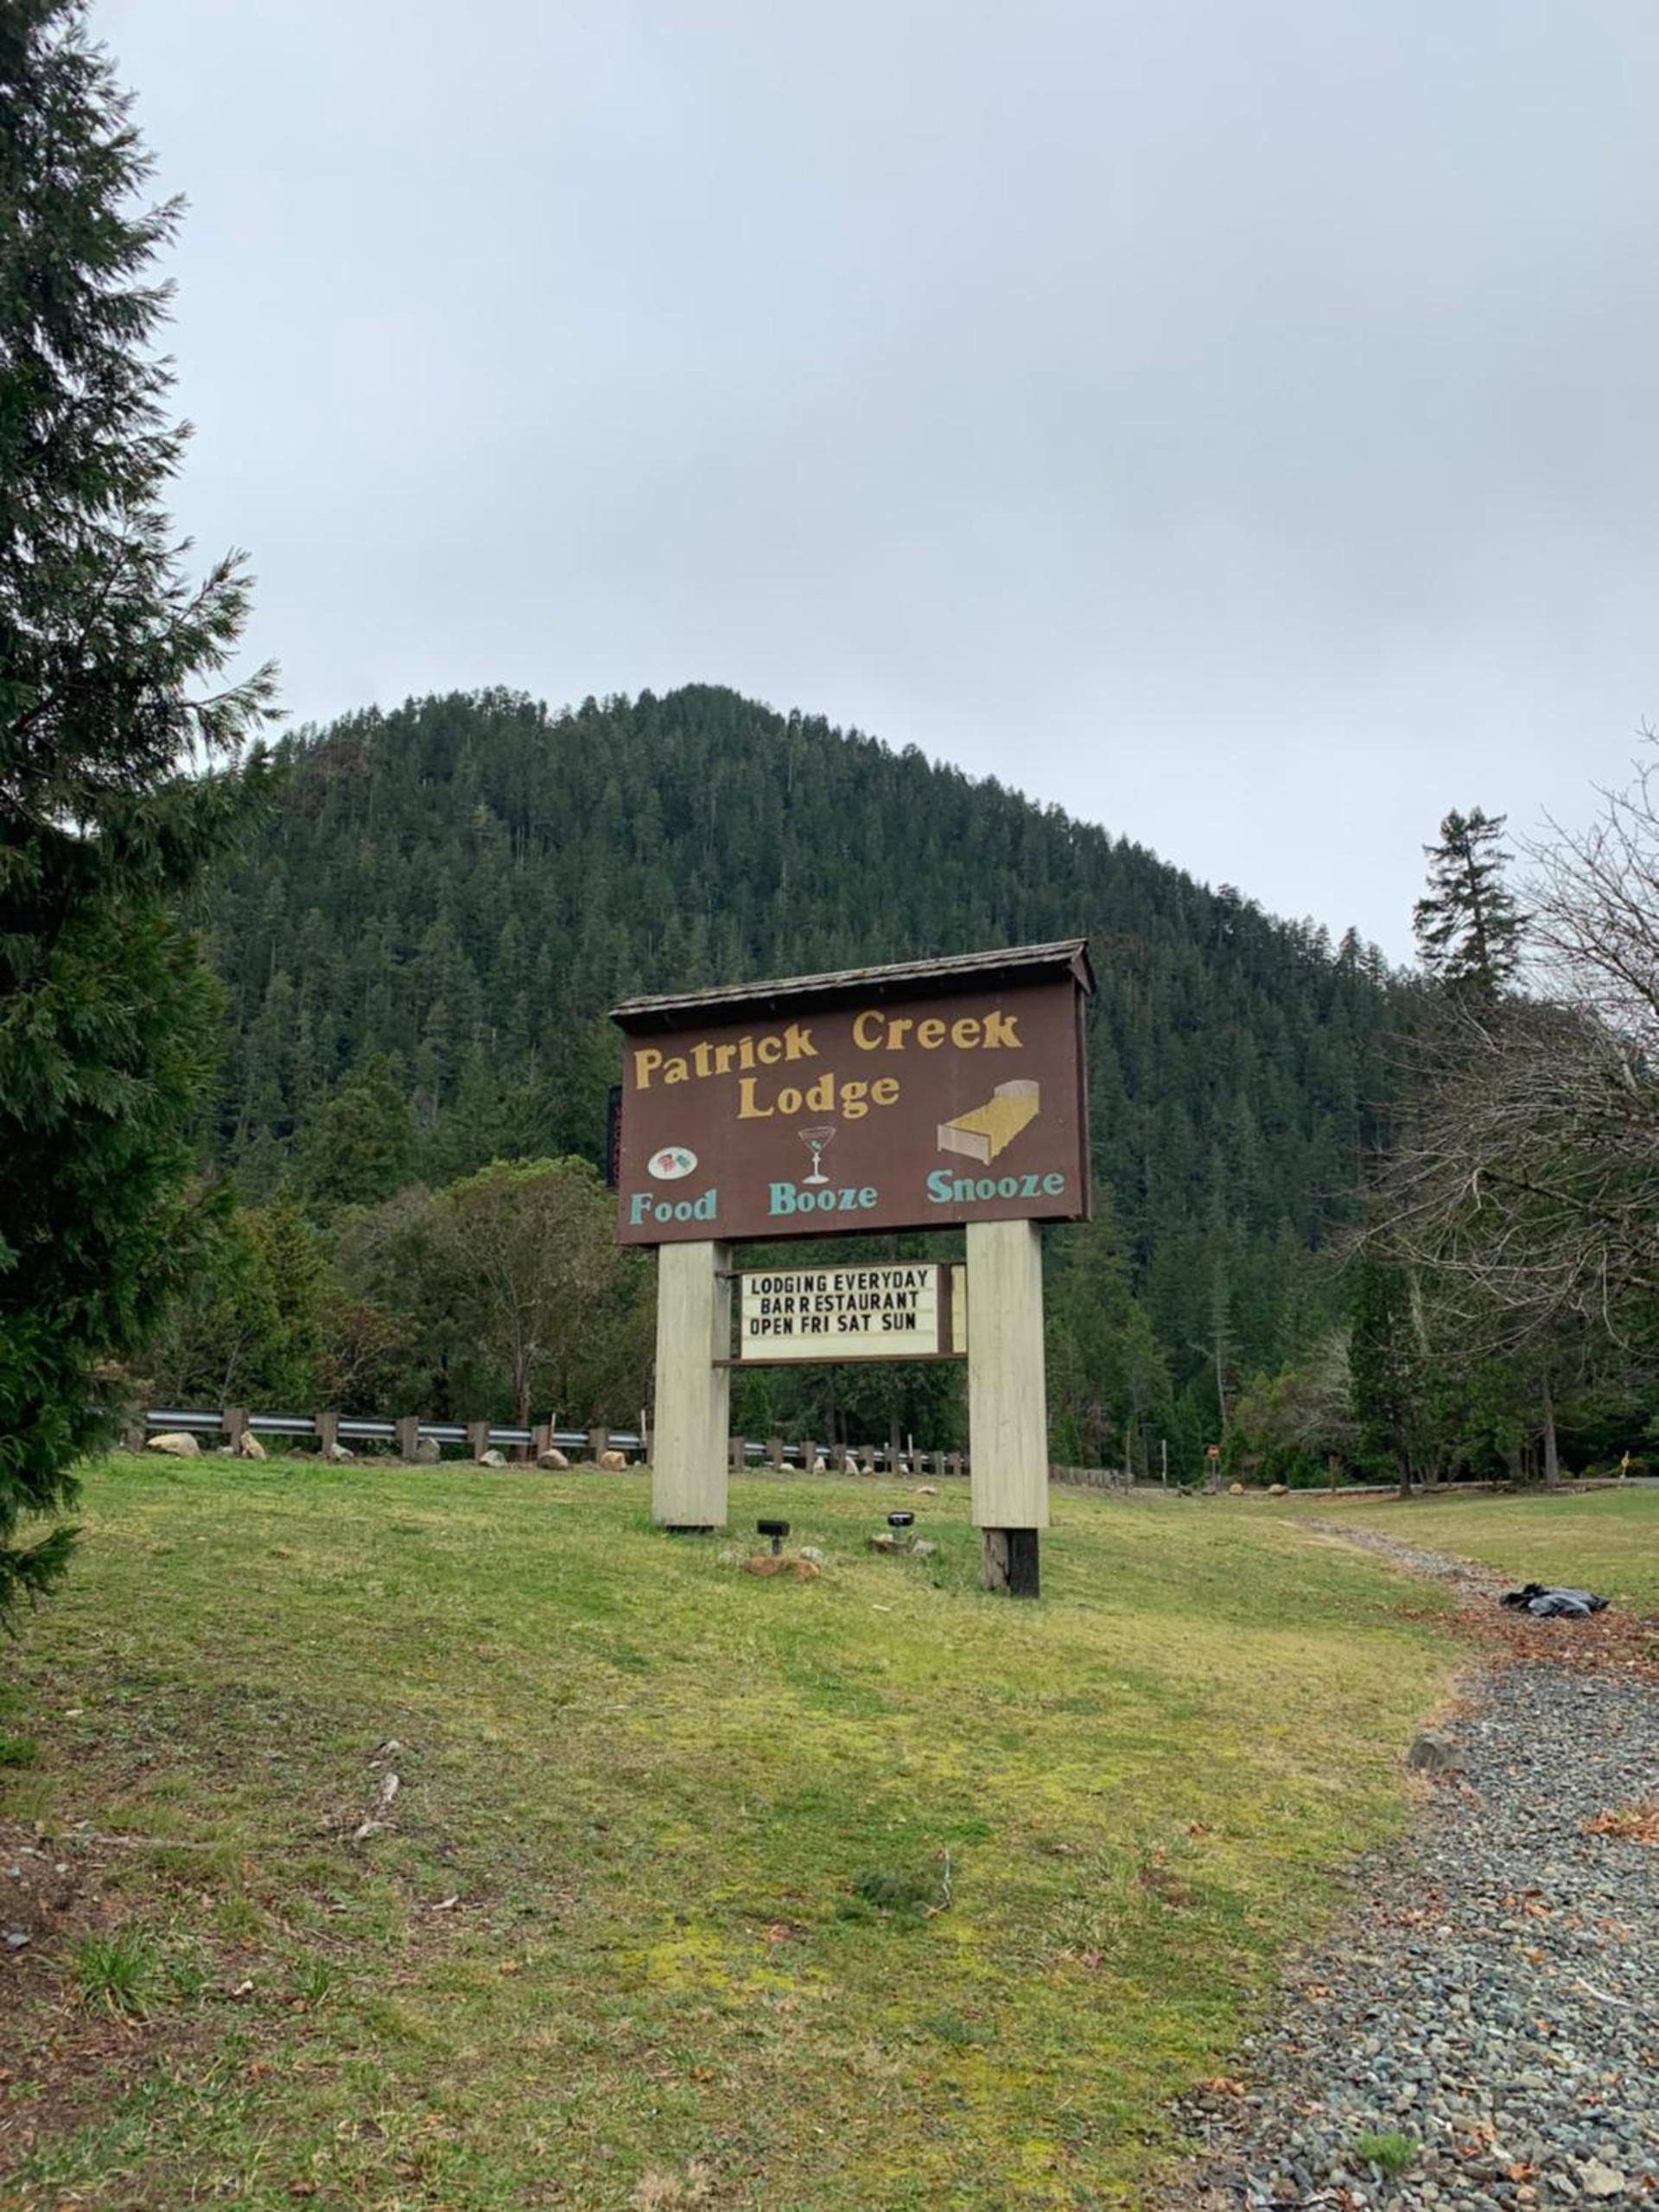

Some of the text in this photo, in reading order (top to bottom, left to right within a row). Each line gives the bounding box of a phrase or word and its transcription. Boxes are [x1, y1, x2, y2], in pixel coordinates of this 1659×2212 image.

[634, 1009, 1023, 1090] Patrick Creek
[737, 1072, 900, 1119] Lodge
[768, 1182, 879, 1216] Booze
[926, 1169, 1065, 1204] Snooze
[630, 1189, 717, 1225] Food
[751, 1269, 928, 1295] LODGING EVERYDAY
[750, 1312, 916, 1336] OPEN FRI SAT SUN
